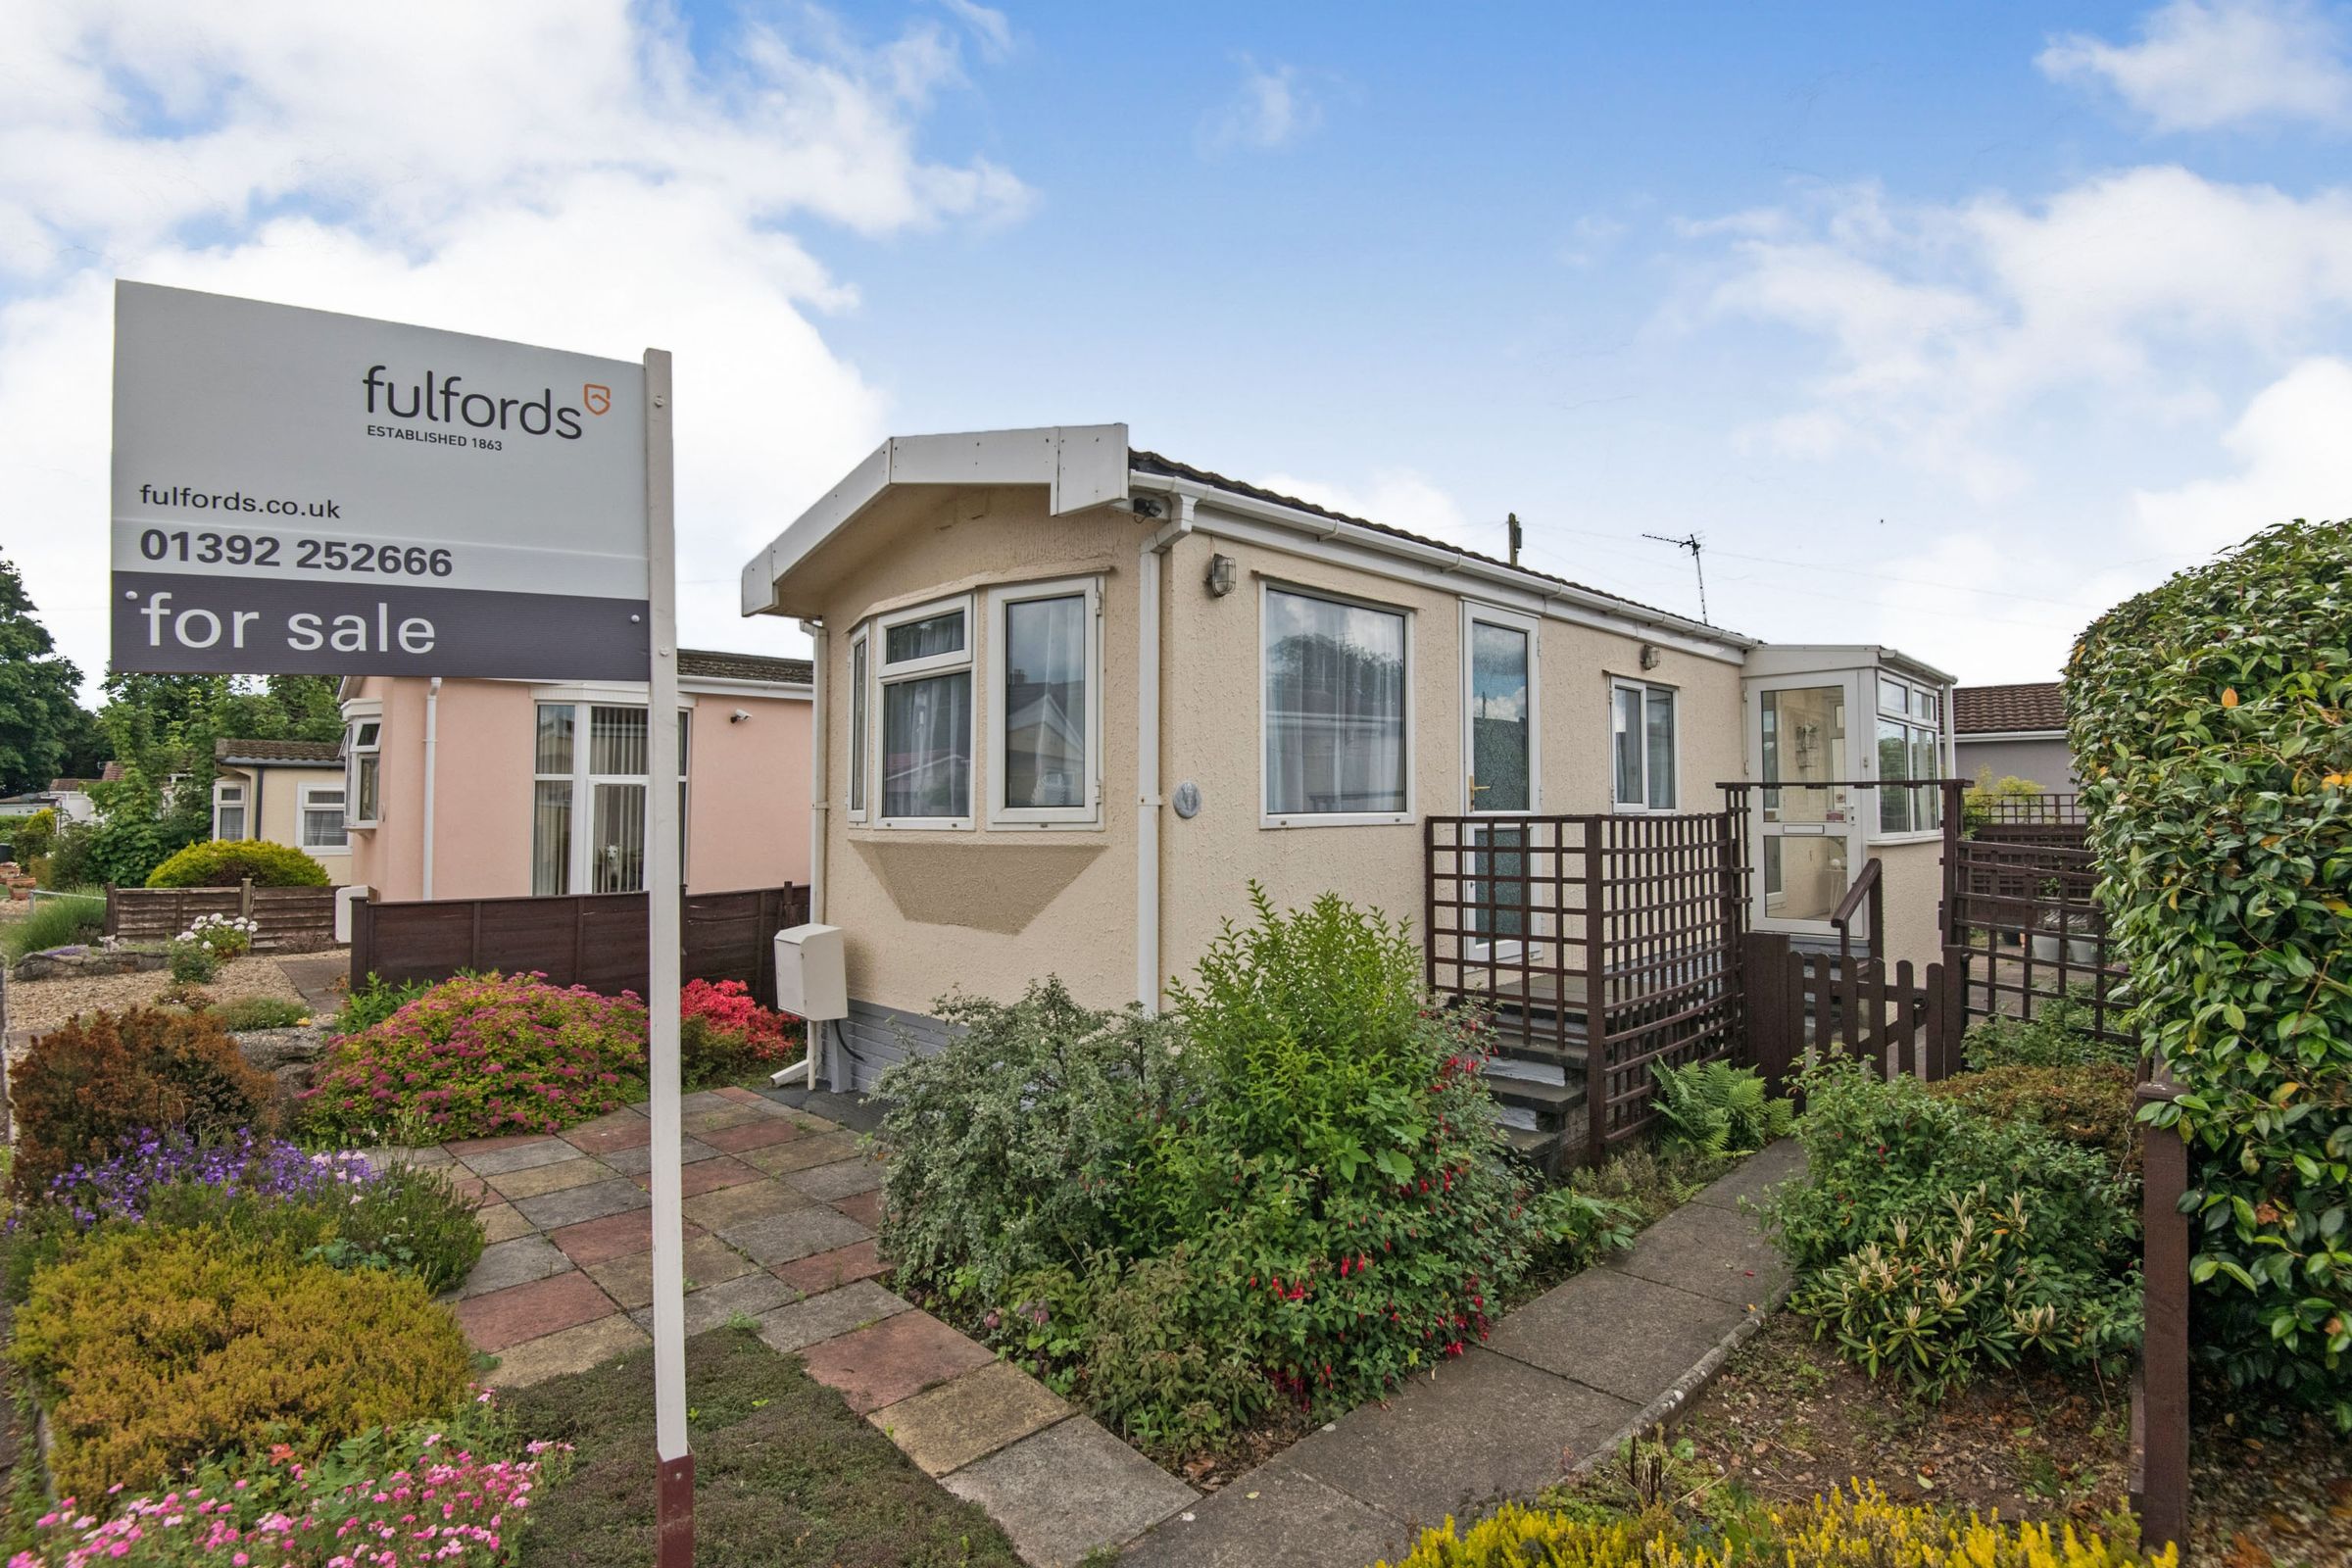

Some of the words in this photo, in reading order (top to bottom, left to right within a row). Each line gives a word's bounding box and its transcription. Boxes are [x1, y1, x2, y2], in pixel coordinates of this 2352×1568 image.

[362, 365, 583, 440] fulfords
[367, 424, 467, 447] ESTABLISHED
[471, 437, 503, 452] 1863
[139, 483, 341, 519] fulfords.co.uk
[139, 528, 281, 567] 01392
[296, 539, 453, 577] 252666
[140, 592, 260, 649] for
[287, 602, 435, 654] sale
